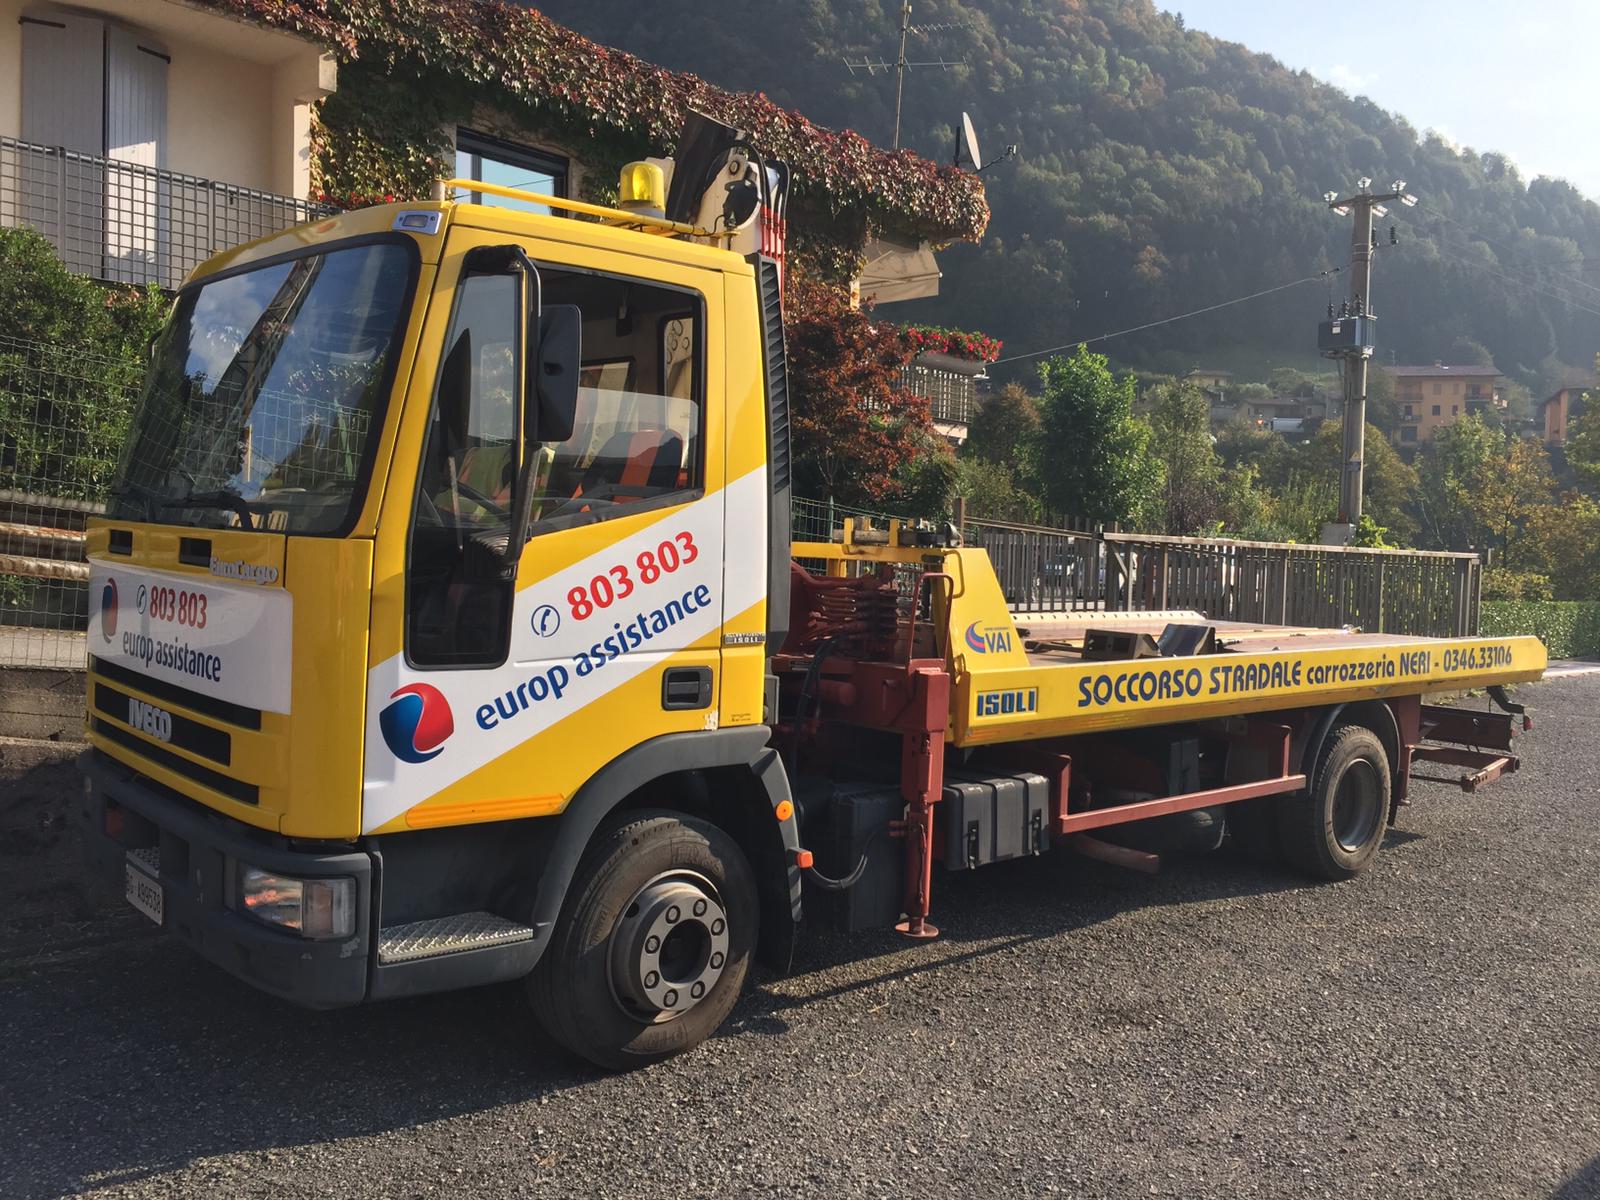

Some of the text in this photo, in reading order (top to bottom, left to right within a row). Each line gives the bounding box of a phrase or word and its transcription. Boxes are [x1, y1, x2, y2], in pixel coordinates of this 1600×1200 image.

[209, 557, 279, 585] EuroCargo
[566, 531, 699, 620] 803 803
[150, 585, 207, 629] 803 803
[122, 630, 221, 682] europ assistance
[474, 583, 712, 731] europ assistance
[984, 631, 1012, 654] VAI
[1078, 668, 1203, 707] SOCCORSO
[1209, 660, 1302, 694] STRADALE
[1306, 653, 1396, 685] carrozzeria
[1399, 650, 1431, 676] NERI
[1443, 645, 1513, 673] 0346.33106
[128, 698, 172, 742] IVECO
[976, 691, 1036, 716] ISOLI
